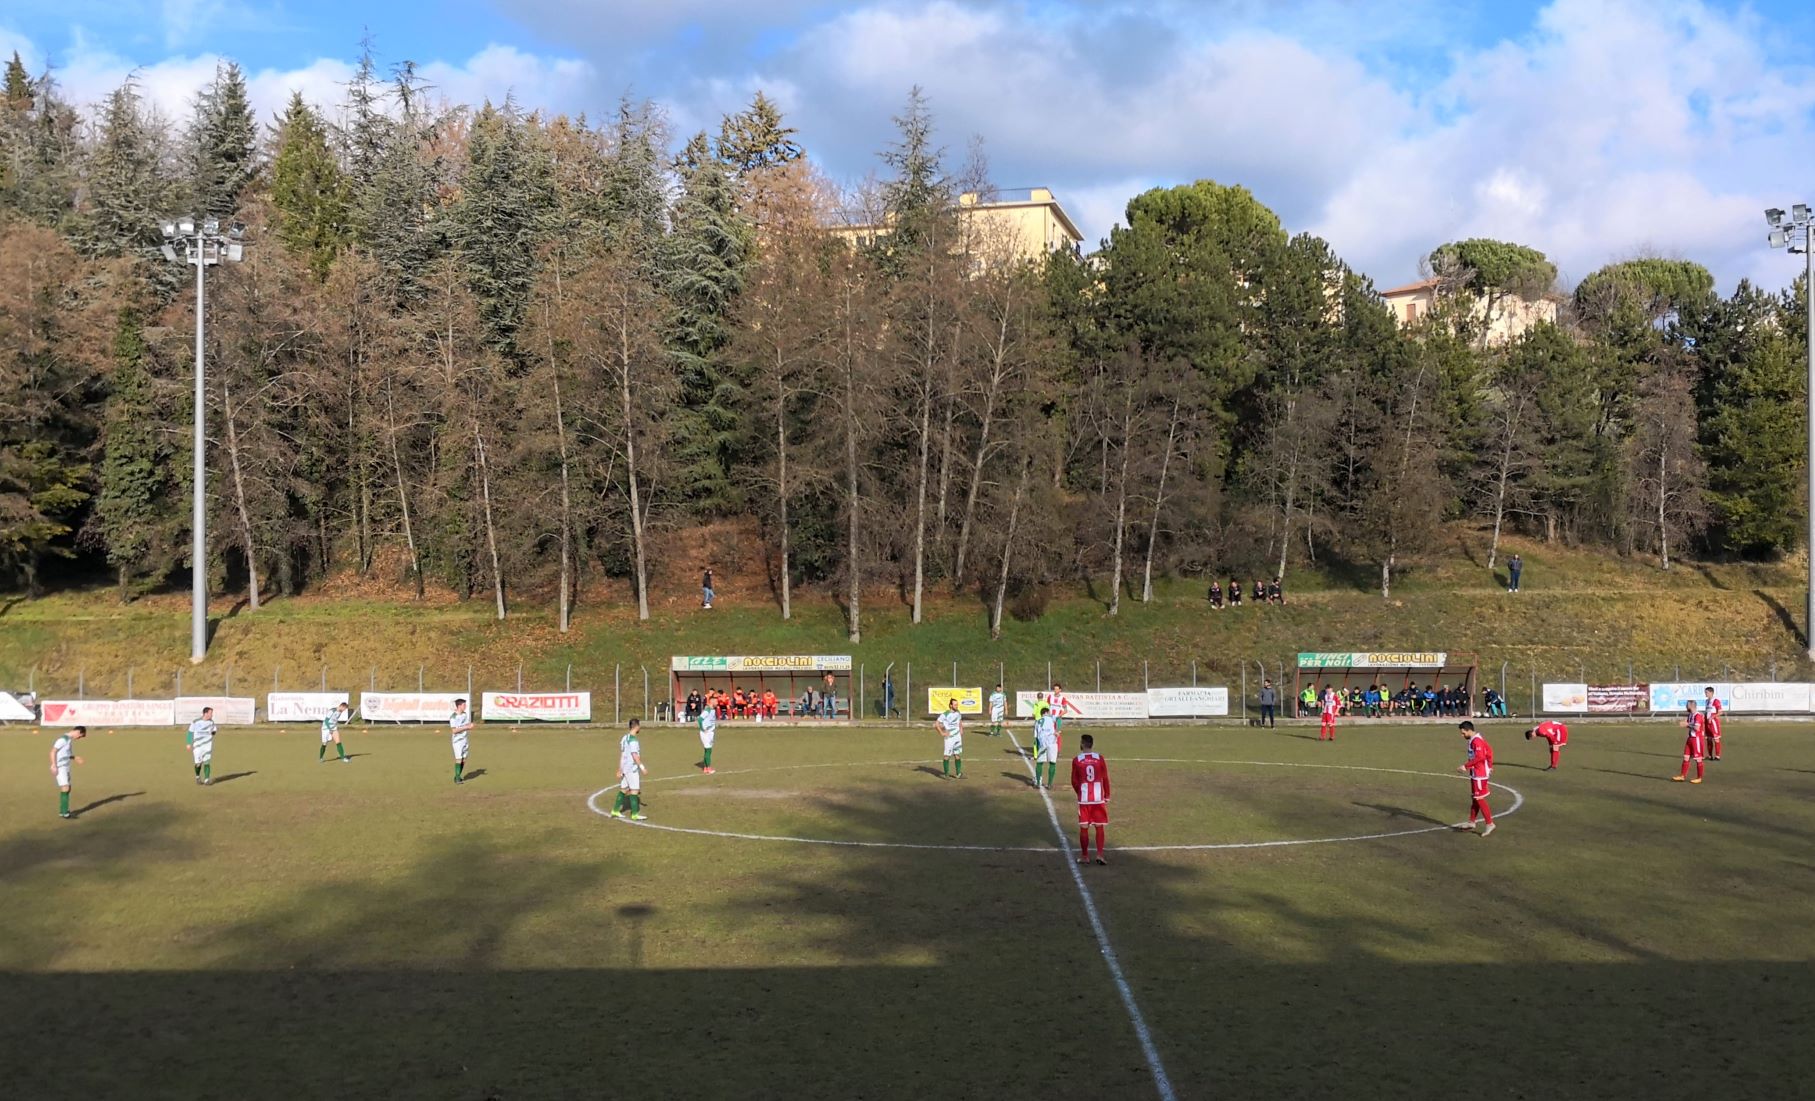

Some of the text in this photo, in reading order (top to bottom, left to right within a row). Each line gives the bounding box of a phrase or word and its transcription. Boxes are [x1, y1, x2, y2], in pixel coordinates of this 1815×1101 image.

[1299, 659, 1321, 667] PER
[270, 702, 288, 715] La
[1086, 765, 1095, 782] 9
